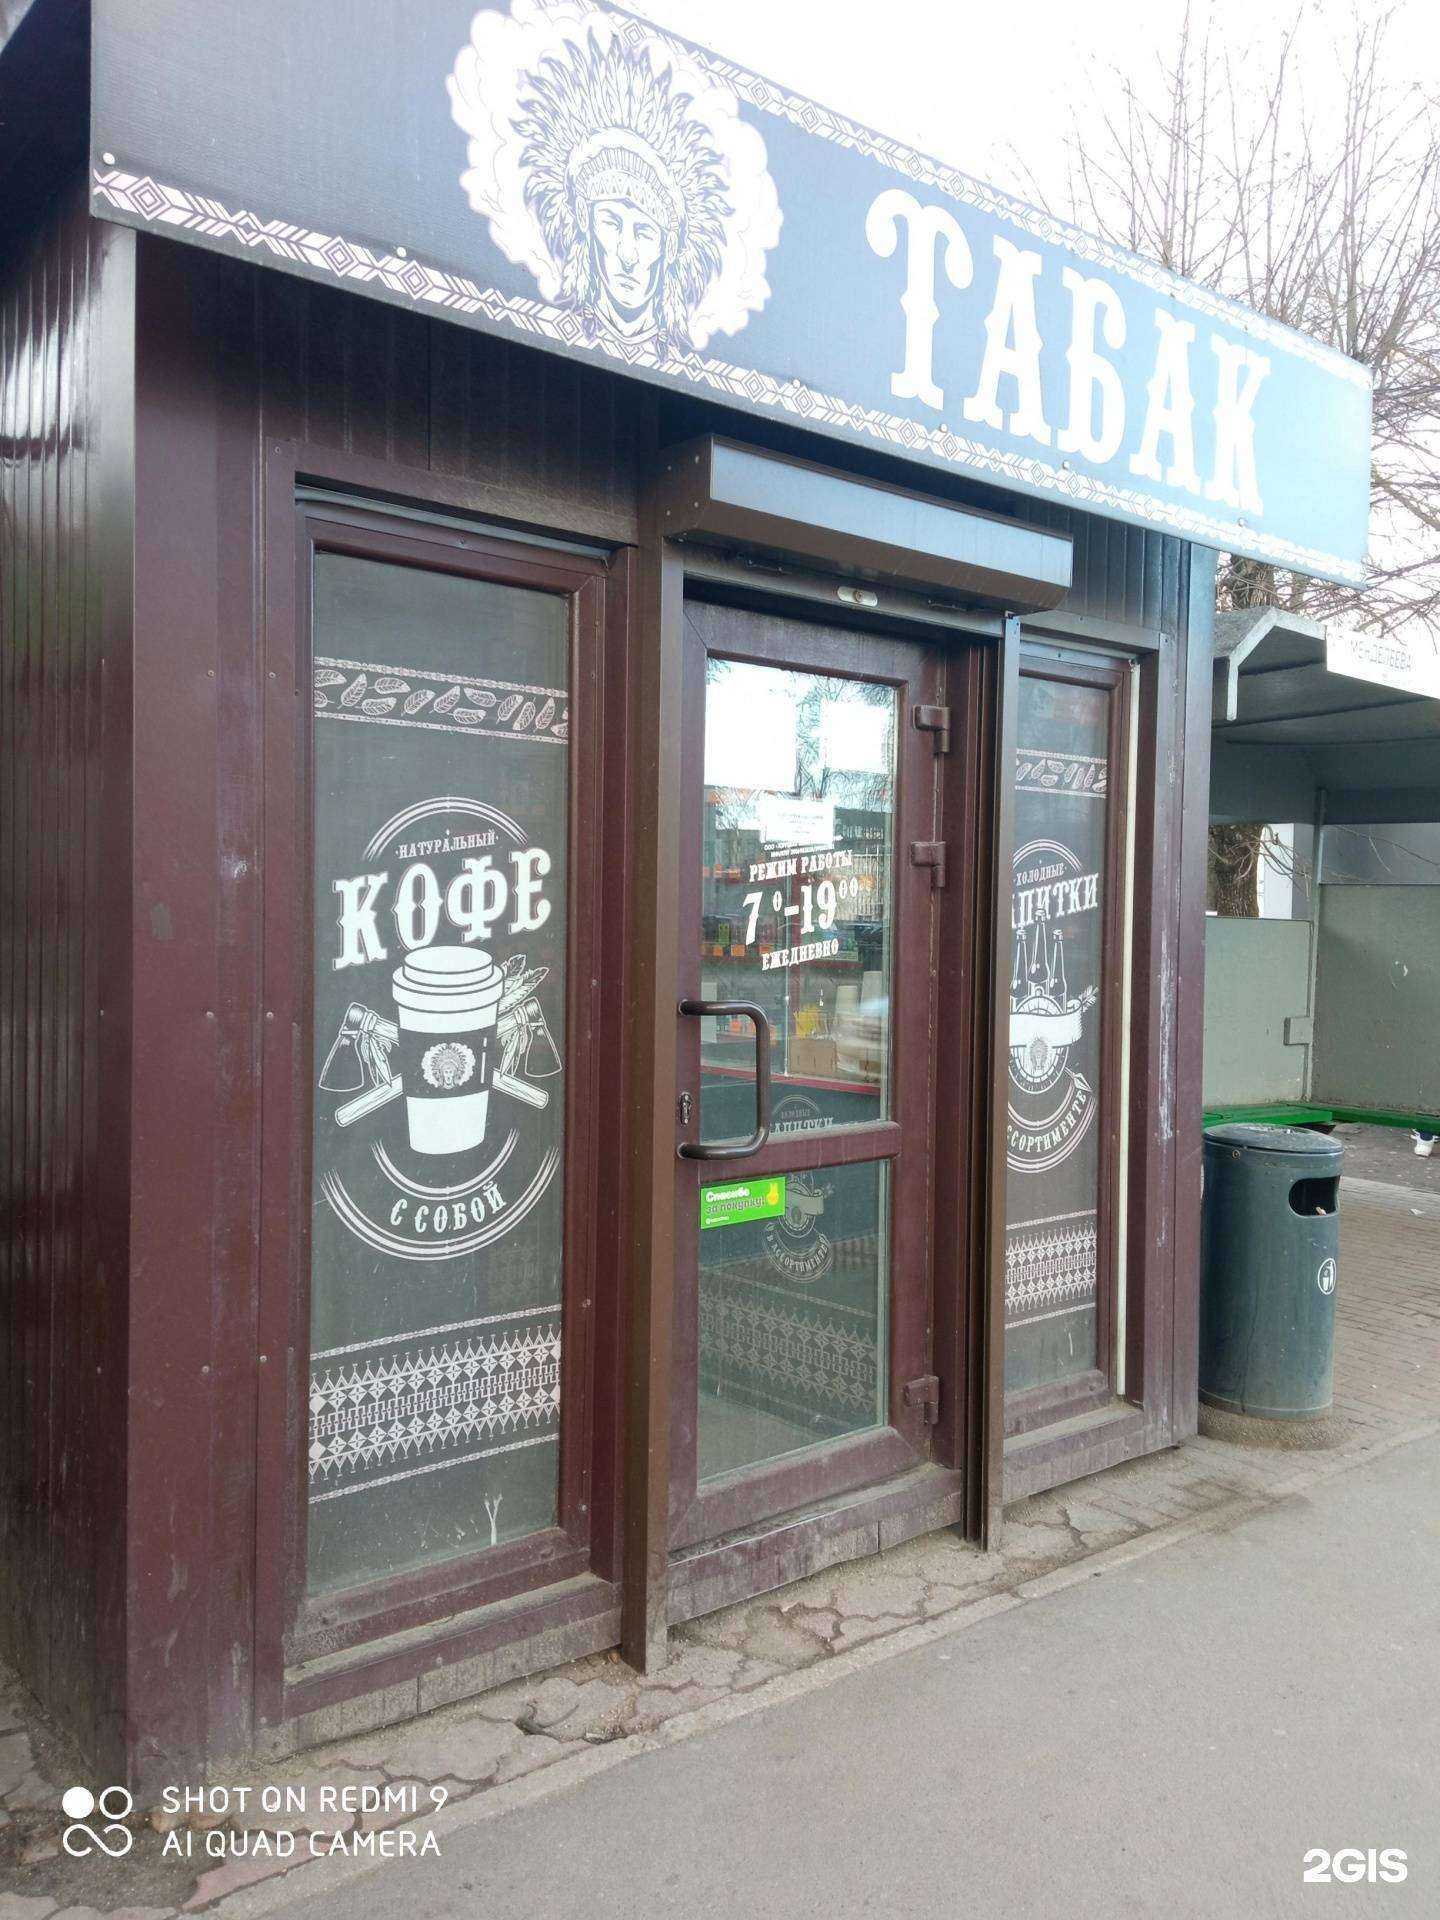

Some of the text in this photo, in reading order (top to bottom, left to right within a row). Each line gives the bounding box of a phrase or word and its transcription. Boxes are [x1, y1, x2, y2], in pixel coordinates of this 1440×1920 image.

[865, 188, 1271, 517] ТАБАК
[398, 828, 497, 860] НАТУРАЛЬНЫЙ
[748, 857, 799, 883] РЕЖИМ
[800, 849, 853, 874] РАБОТЫ
[1016, 862, 1065, 886] ХОЛОДНЫЕ
[332, 847, 552, 971] КОФЕ
[761, 938, 840, 971] ЕЖЕДНЕВНО
[390, 1180, 507, 1233] С СОБОЙ
